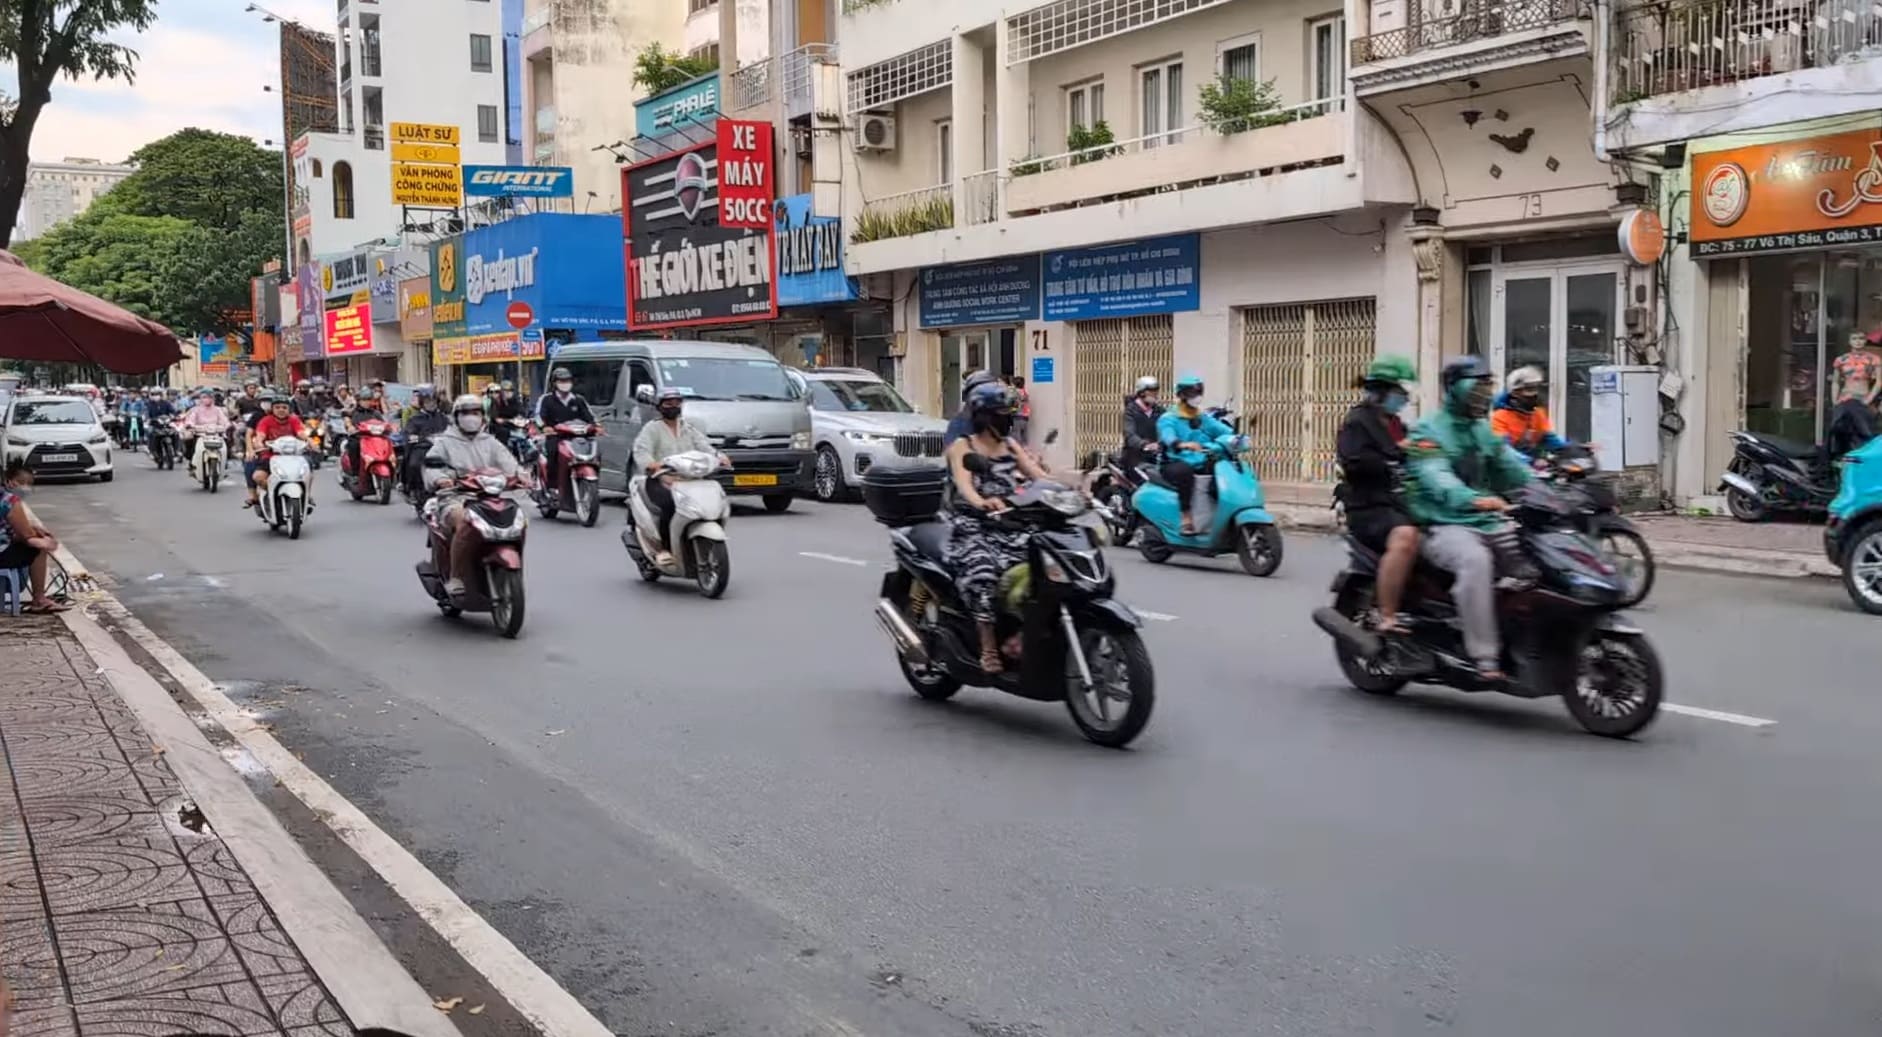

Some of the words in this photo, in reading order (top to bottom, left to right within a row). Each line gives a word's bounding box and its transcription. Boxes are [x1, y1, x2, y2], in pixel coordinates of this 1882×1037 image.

[700, 84, 715, 105] LÊ
[398, 125, 431, 141] LUẬT
[435, 128, 452, 140] SƯ
[733, 125, 756, 150] XE
[400, 167, 419, 178] VĂN
[421, 167, 453, 179] PHÒNG
[470, 170, 565, 185] GIANT
[724, 156, 765, 186] MÁY
[396, 178, 423, 191] CÔNG
[425, 179, 458, 192] CHỨNG
[502, 185, 554, 193] INTERNATIONAL
[725, 197, 767, 222] 50CC
[1520, 194, 1542, 219] 73
[1722, 241, 1735, 252] 75
[1744, 239, 1756, 249] 77
[1759, 236, 1775, 248] Võ
[1777, 235, 1796, 248] Thị
[1798, 232, 1823, 246] Sáu,
[1827, 230, 1857, 242] Quận
[1860, 229, 1872, 240] 3,
[630, 240, 661, 300] THẾ
[661, 238, 698, 296] GIỚI
[698, 243, 724, 292] XE
[724, 228, 771, 299] ĐIỆN
[962, 297, 981, 308] SOCIAL
[998, 294, 1020, 305] CENTER
[1032, 329, 1050, 351] 71
